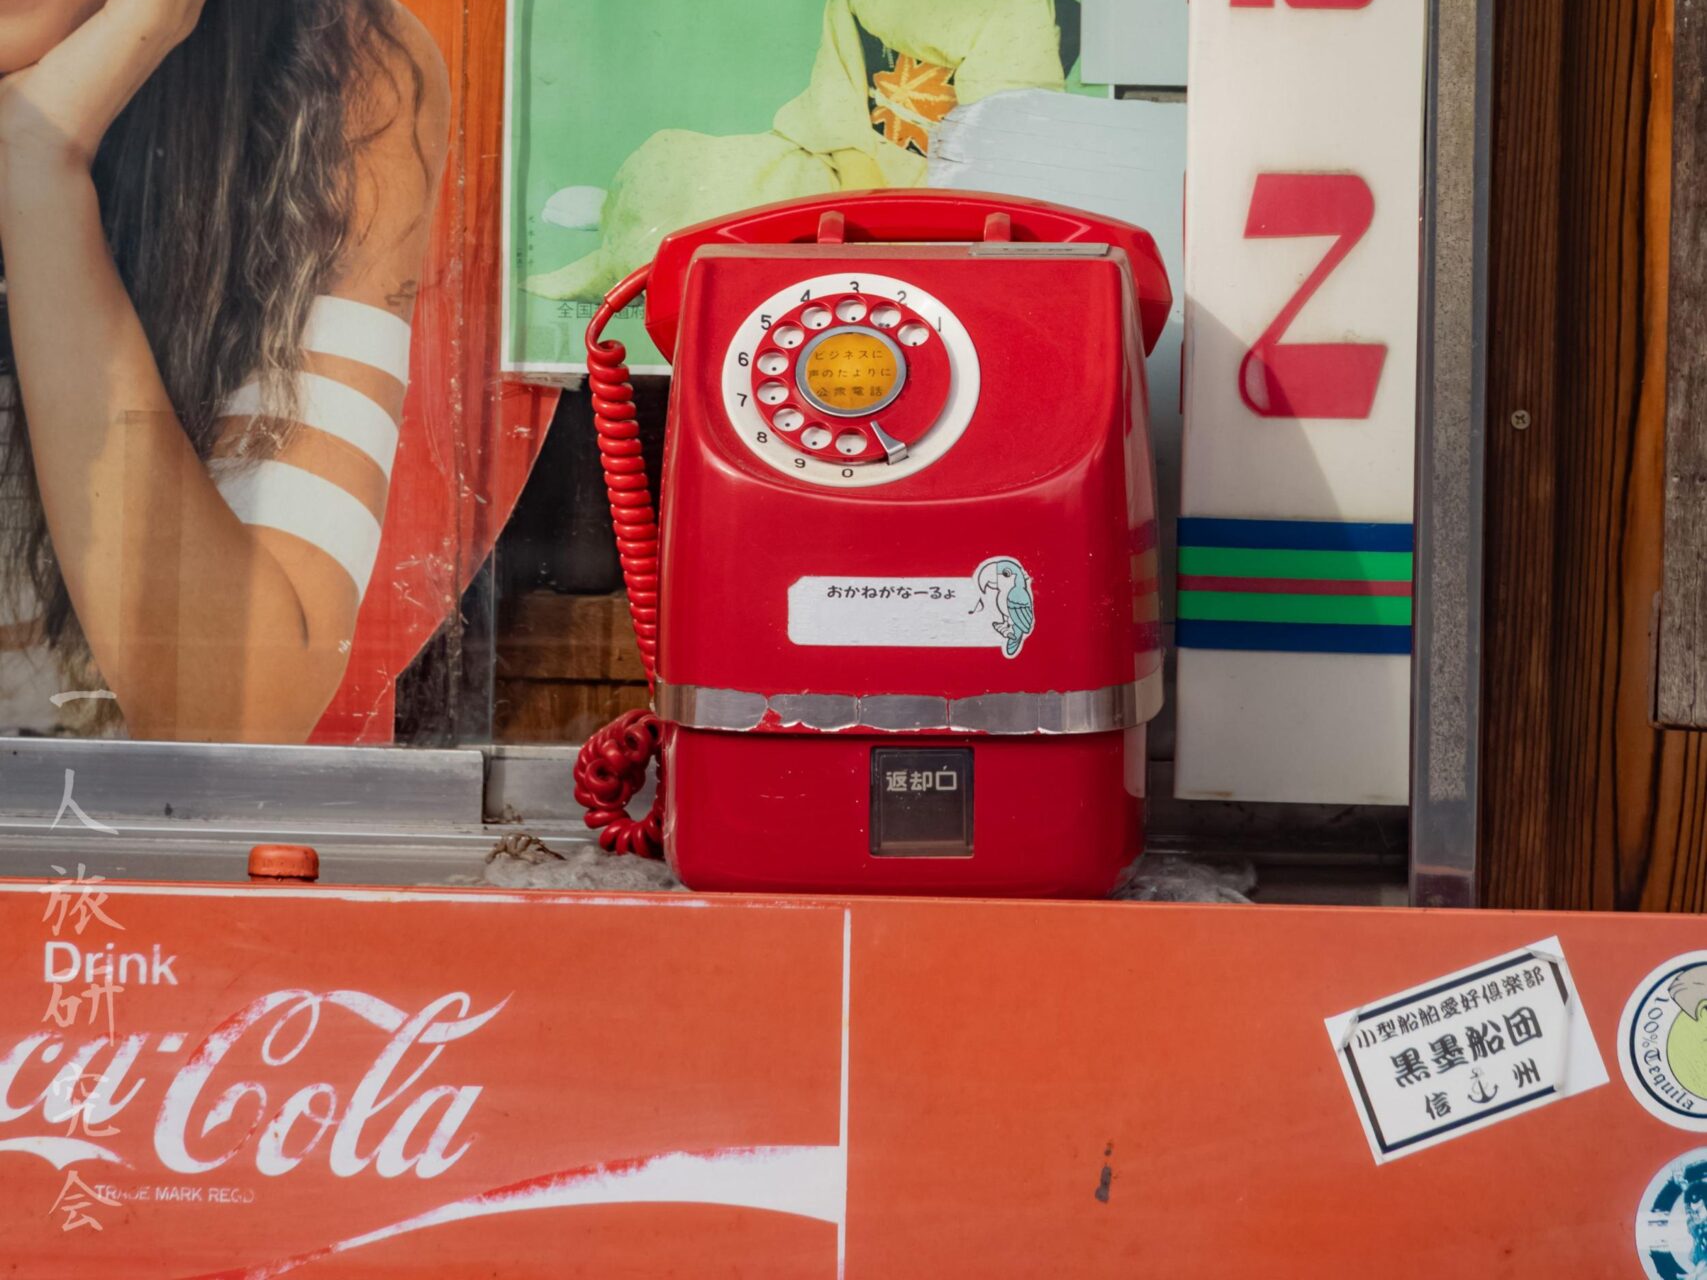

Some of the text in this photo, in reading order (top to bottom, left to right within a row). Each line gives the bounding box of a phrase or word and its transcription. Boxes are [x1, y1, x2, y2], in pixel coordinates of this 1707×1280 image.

[849, 281, 860, 294] 3
[800, 289, 811, 303] 4
[897, 290, 907, 306] 2
[761, 314, 772, 330] 5
[738, 351, 749, 367] 6
[815, 350, 883, 361] ビジネスに
[808, 368, 892, 380] 声のたよりに
[736, 392, 748, 407] 7
[756, 431, 768, 444] 8
[794, 457, 806, 469] 9
[885, 771, 957, 792] 返却口
[44, 941, 178, 986] Drink
[1356, 966, 1546, 1049] 小型船舶愛好倶楽部
[1424, 1058, 1541, 1121] 信 州
[155, 1186, 203, 1202] MARK
